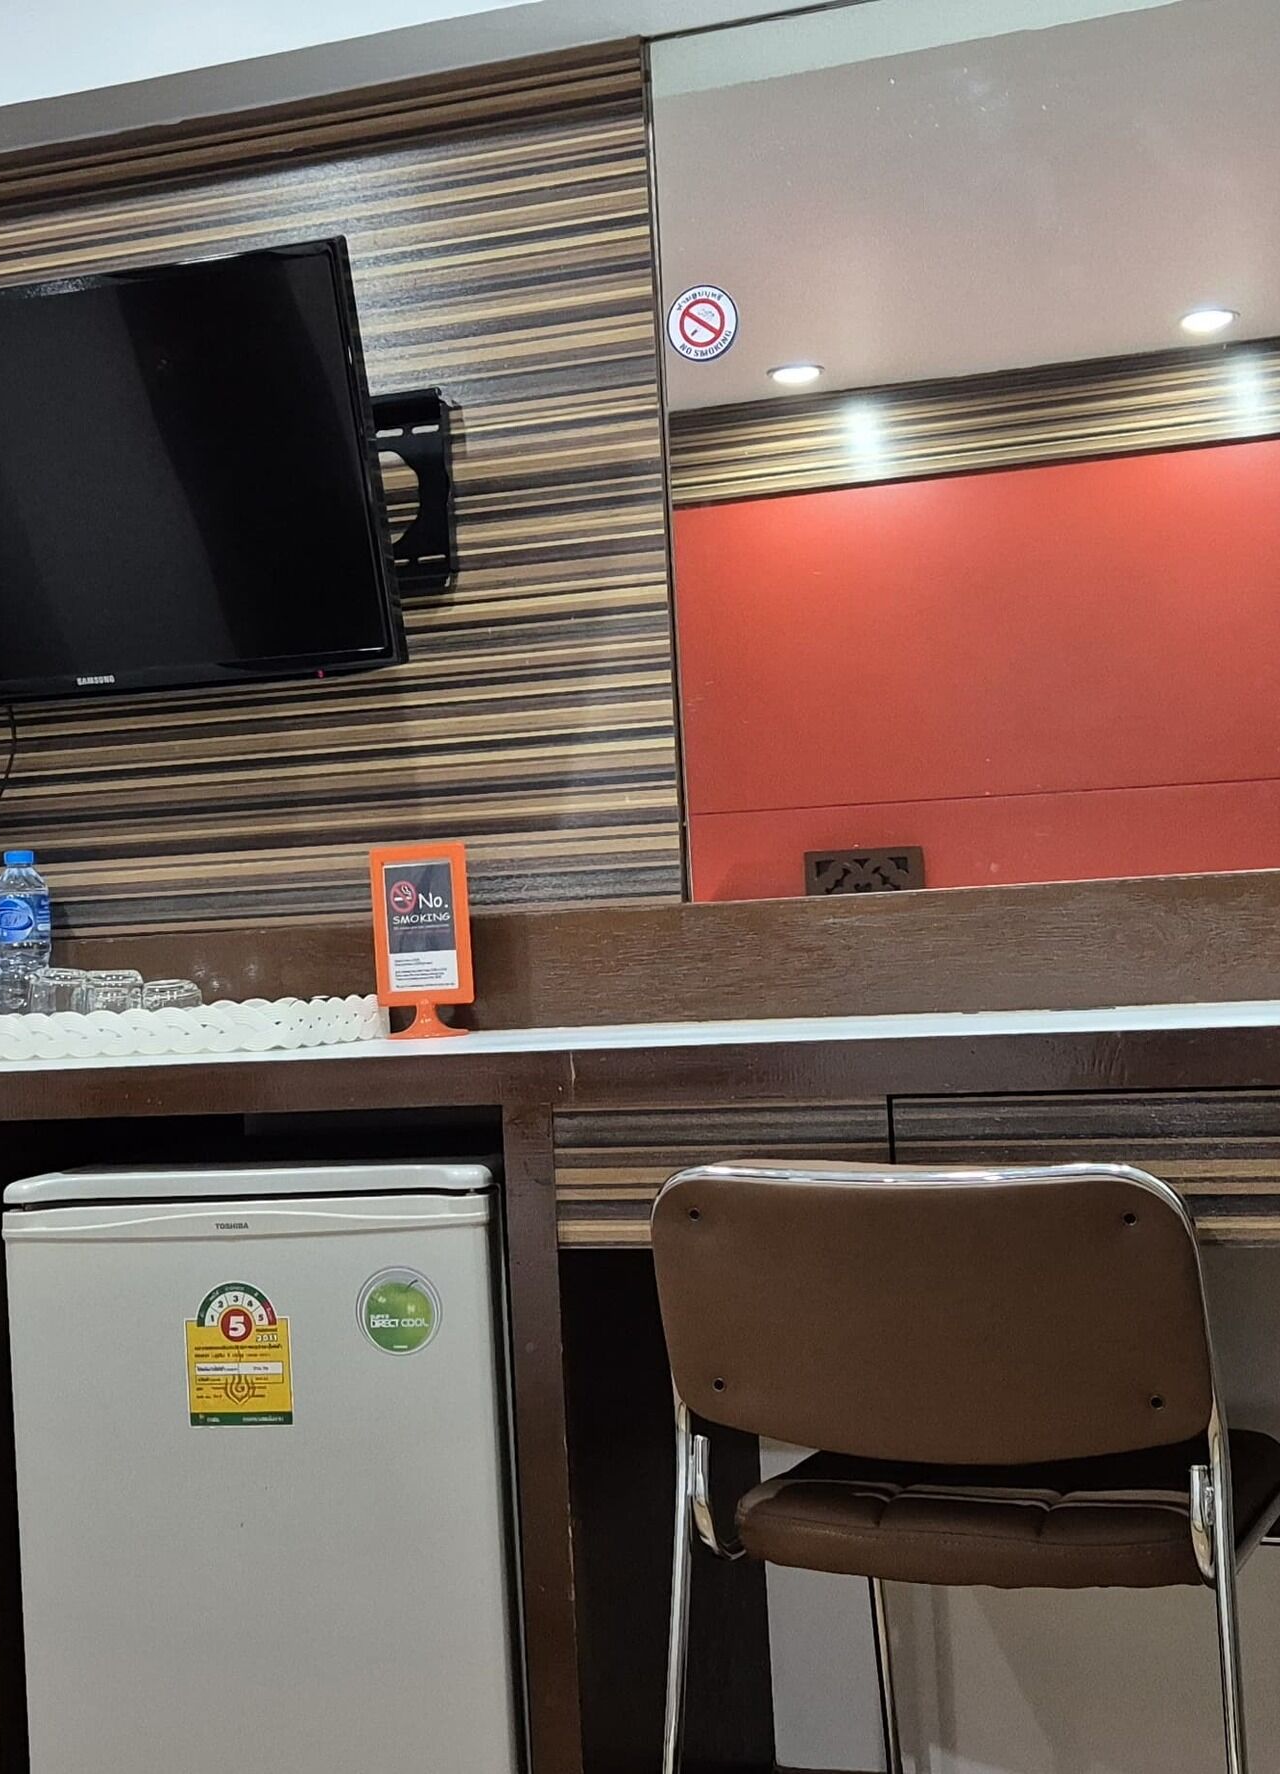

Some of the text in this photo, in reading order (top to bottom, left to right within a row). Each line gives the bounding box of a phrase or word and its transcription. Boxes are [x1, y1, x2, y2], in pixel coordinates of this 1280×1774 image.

[680, 330, 732, 357] NO SMOKING
[418, 891, 449, 910] No.
[392, 912, 451, 925] SMOKING
[215, 1222, 249, 1230] TOSHIBA
[218, 1300, 224, 1309] 2
[232, 1295, 239, 1303] 3
[246, 1300, 254, 1308] 4
[258, 1313, 264, 1322] 5
[228, 1315, 246, 1338] 5
[370, 1317, 430, 1329] DIRECT COOL
